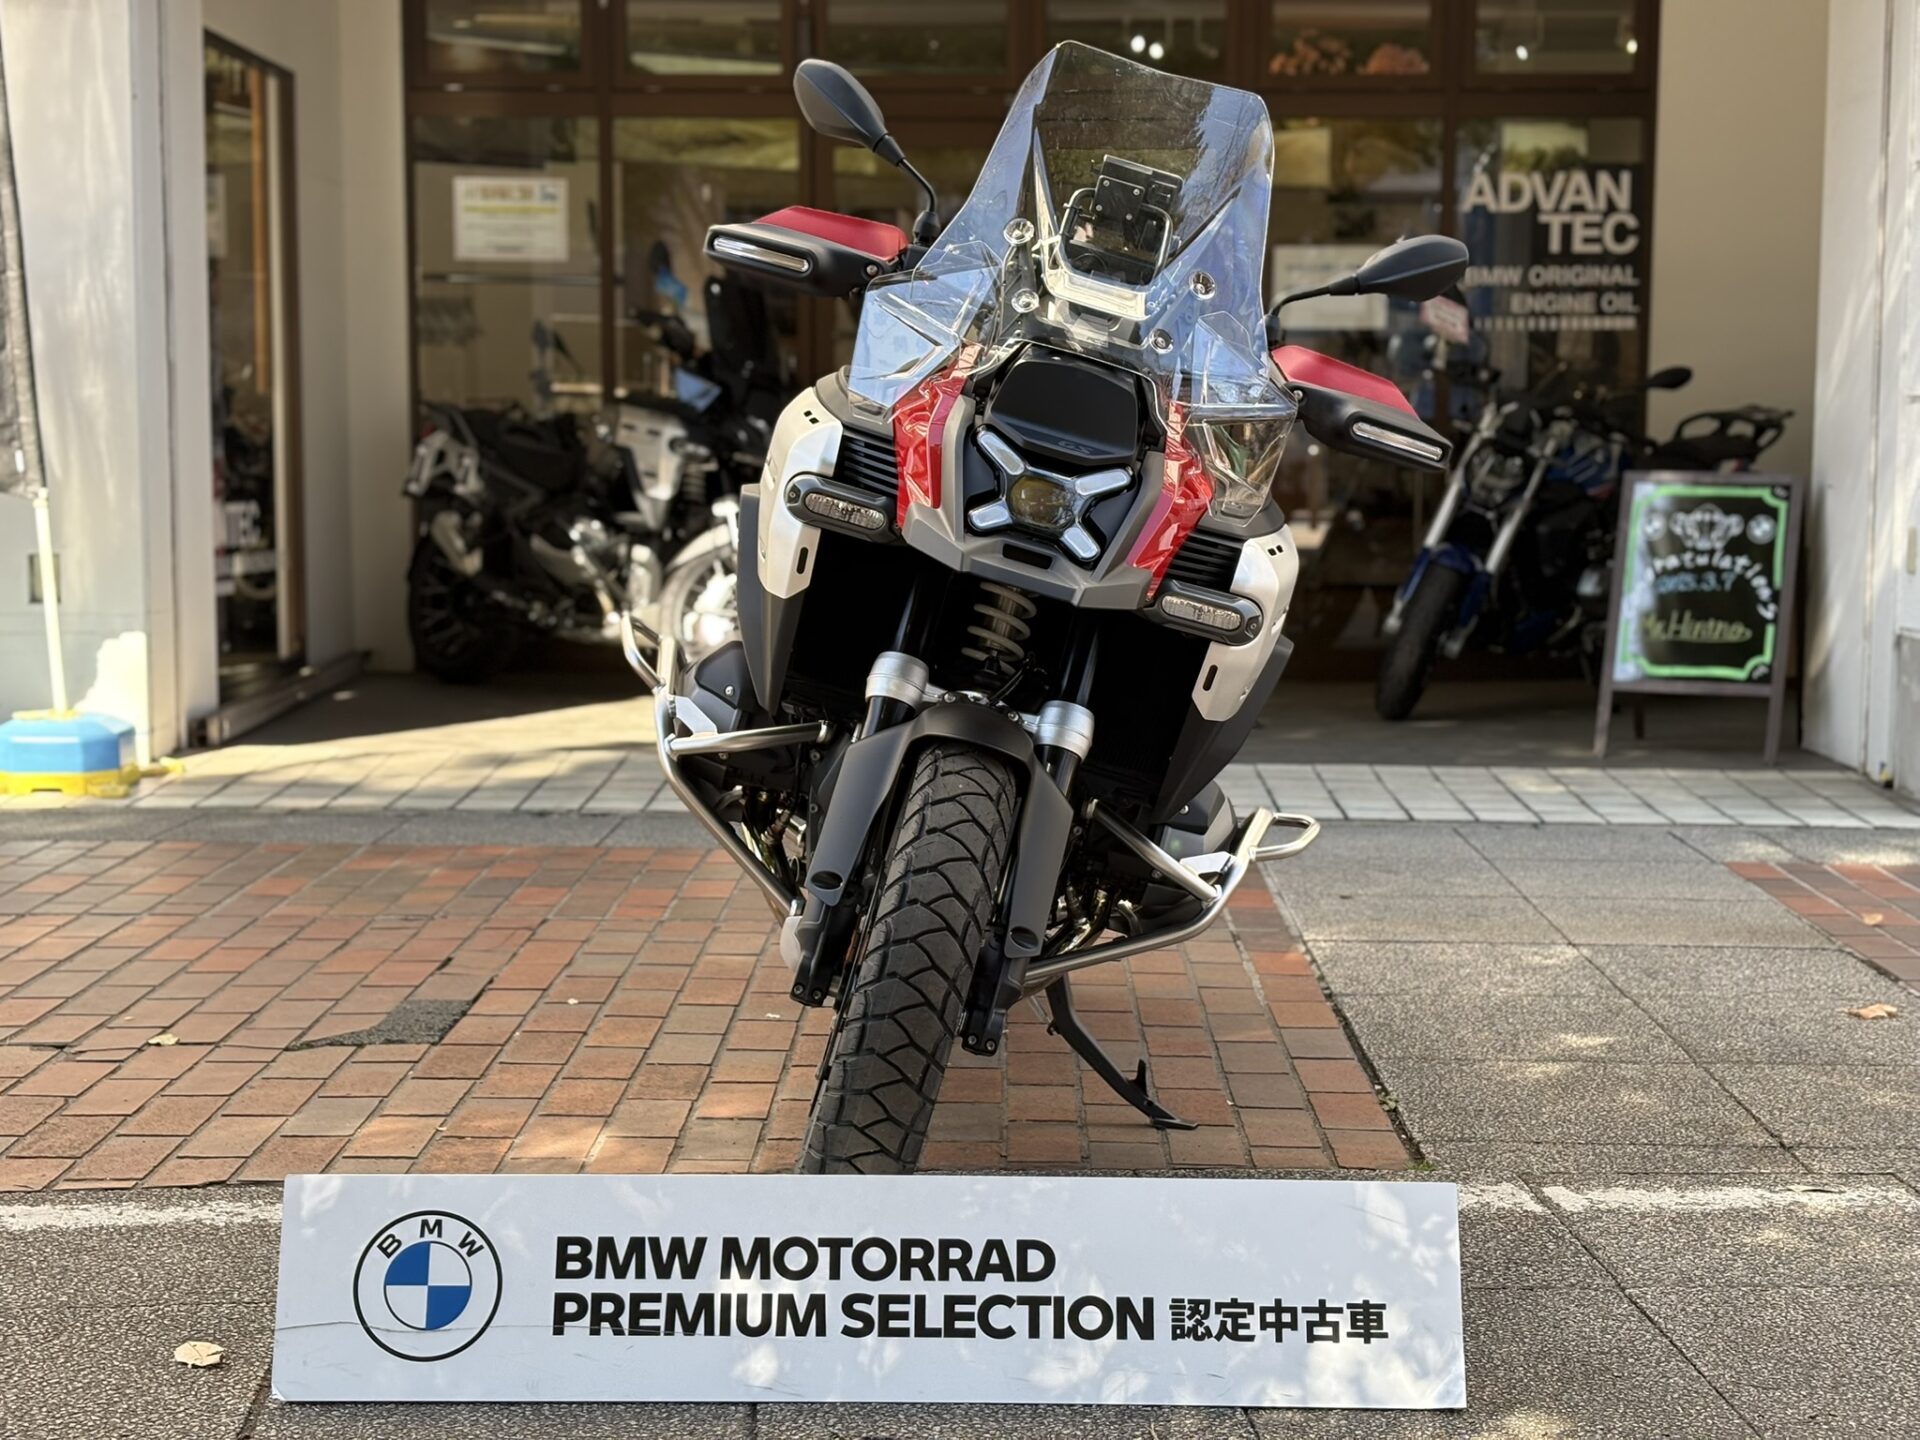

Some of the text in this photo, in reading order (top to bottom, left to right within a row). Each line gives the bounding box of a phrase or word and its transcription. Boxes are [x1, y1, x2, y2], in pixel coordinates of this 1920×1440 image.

[1464, 171, 1632, 212] ADVAN
[1537, 212, 1639, 255] TEC
[1528, 264, 1639, 286] ORIGINAL
[1510, 292, 1640, 314] ENGINE OIL
[377, 1218, 484, 1259] BMW
[555, 1236, 1056, 1283] BMW MOTORRAD
[552, 1292, 1389, 1344] PREMIUM SELECTION 認定中古車
